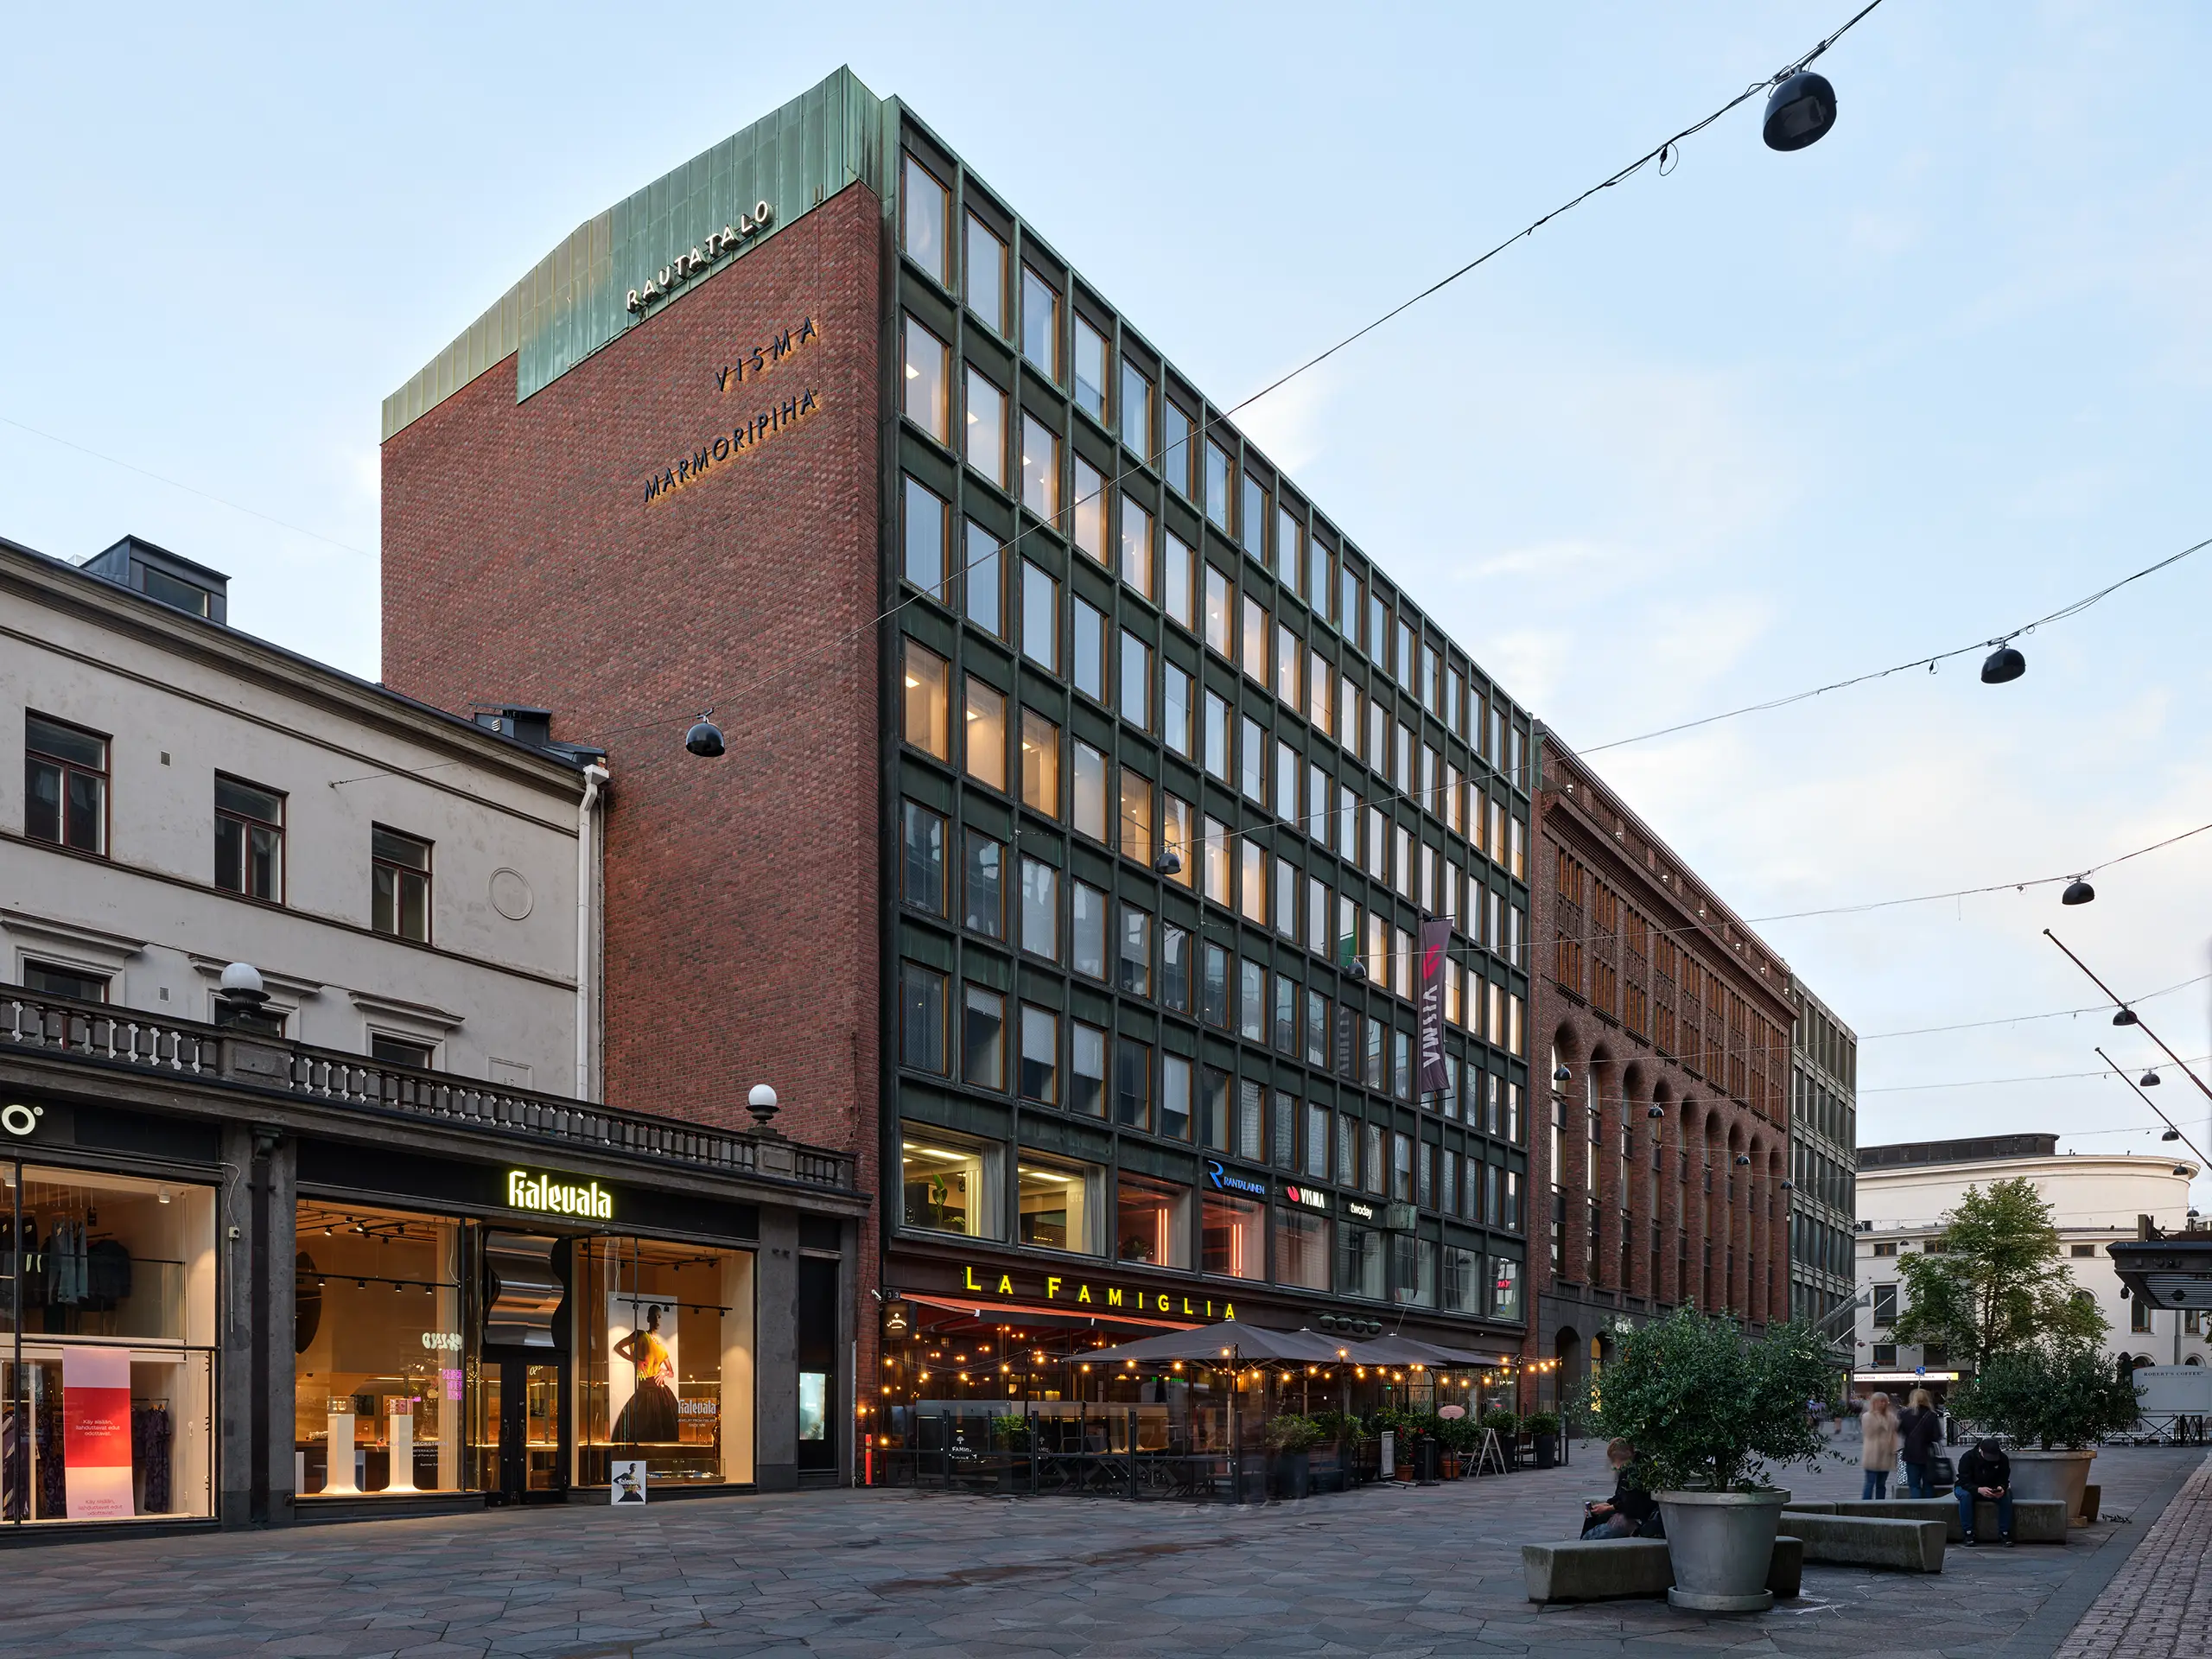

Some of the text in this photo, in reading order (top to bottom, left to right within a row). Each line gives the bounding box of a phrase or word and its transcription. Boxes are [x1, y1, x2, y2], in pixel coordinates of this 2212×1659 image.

[627, 200, 772, 314] RAUTATALO
[715, 316, 817, 391] VISMA
[644, 388, 816, 503] MARMORIPIHA
[1423, 984, 1440, 1068] VISMA
[509, 1170, 612, 1219] Kalevala
[1224, 1176, 1265, 1195] RANTALAINEN
[1300, 1188, 1325, 1209] VISMA
[1350, 1202, 1373, 1219] twoday
[964, 1266, 1236, 1320] LA FAMIGLIA
[677, 1399, 716, 1414] Kalevala
